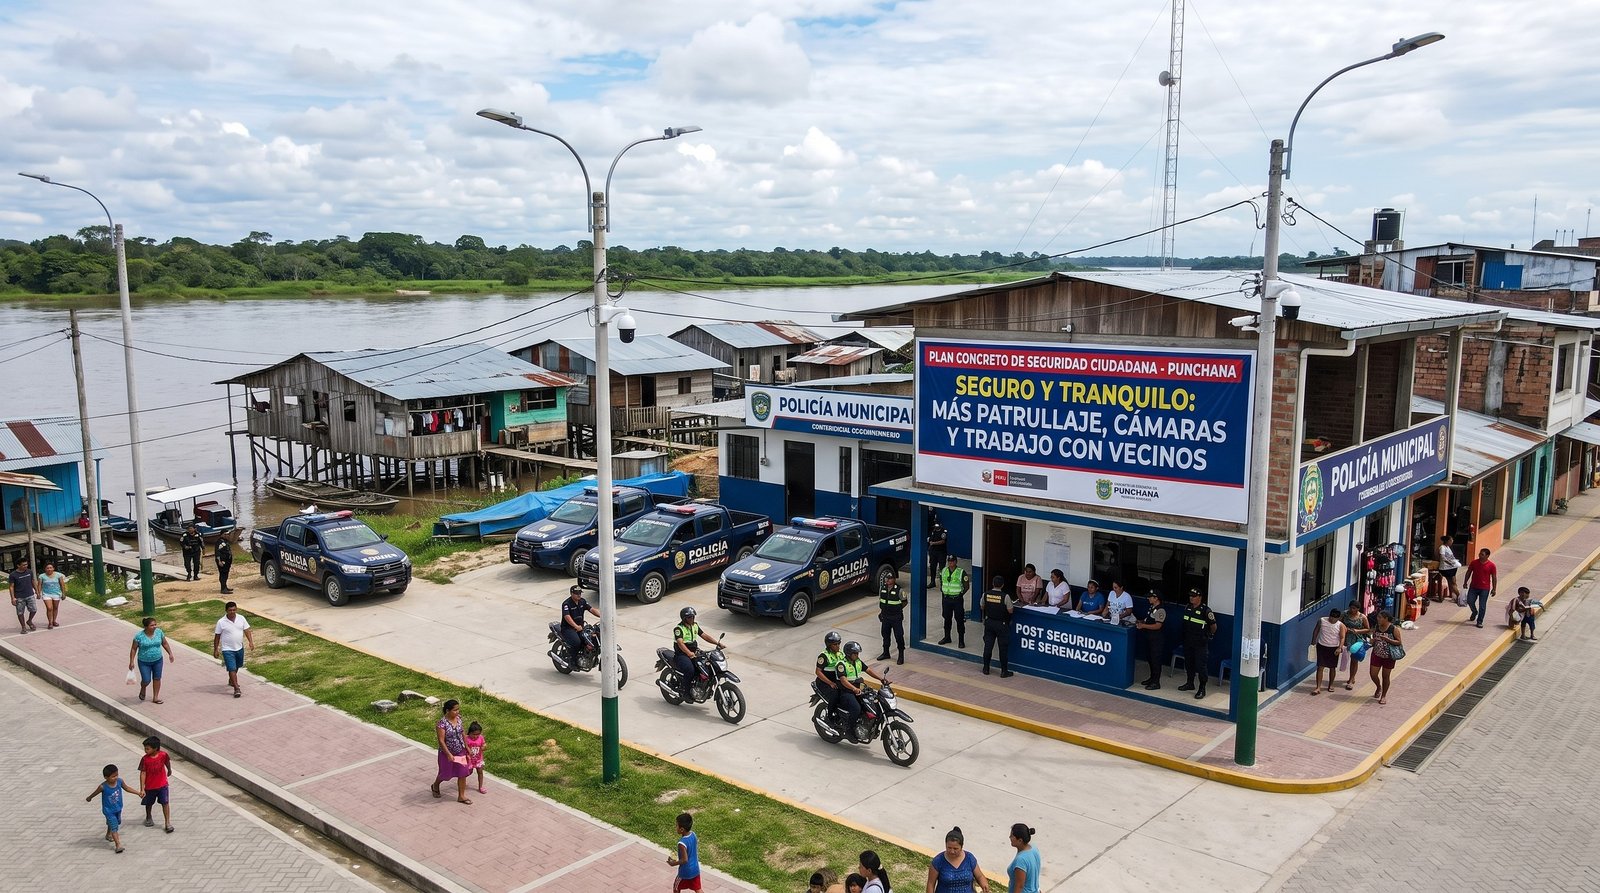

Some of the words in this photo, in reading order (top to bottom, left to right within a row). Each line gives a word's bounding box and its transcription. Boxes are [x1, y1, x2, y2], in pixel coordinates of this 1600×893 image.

[929, 350, 954, 364] PLAN
[956, 352, 1009, 367] CONCRETO
[1011, 354, 1025, 367] DE
[1027, 355, 1088, 371] SEGURIDAD
[1090, 358, 1158, 375] CIUDADANA
[1168, 362, 1237, 378] PUNCHANA
[779, 396, 834, 417] POLICÍA
[956, 375, 1035, 400] SEGURO
[1041, 382, 1053, 400] Y
[1060, 381, 1195, 411] TRANQUILO:
[932, 396, 972, 422] MÁS
[977, 403, 1108, 438] PATRULLAJE,
[1114, 410, 1227, 443] CÁMARAS
[946, 426, 960, 446] Y
[963, 428, 1053, 456] TRABAJO
[1058, 436, 1103, 460] CON
[1109, 441, 1207, 471] VECINOS
[1330, 446, 1379, 497] POLICÍA
[1380, 431, 1435, 477] MUNICIPAL
[1113, 486, 1159, 499] PUNCHANA
[1015, 623, 1044, 639] POST
[1046, 629, 1112, 653] SEGURIDAD
[1020, 637, 1037, 651] DE
[1038, 640, 1106, 666] SERENAZGO
